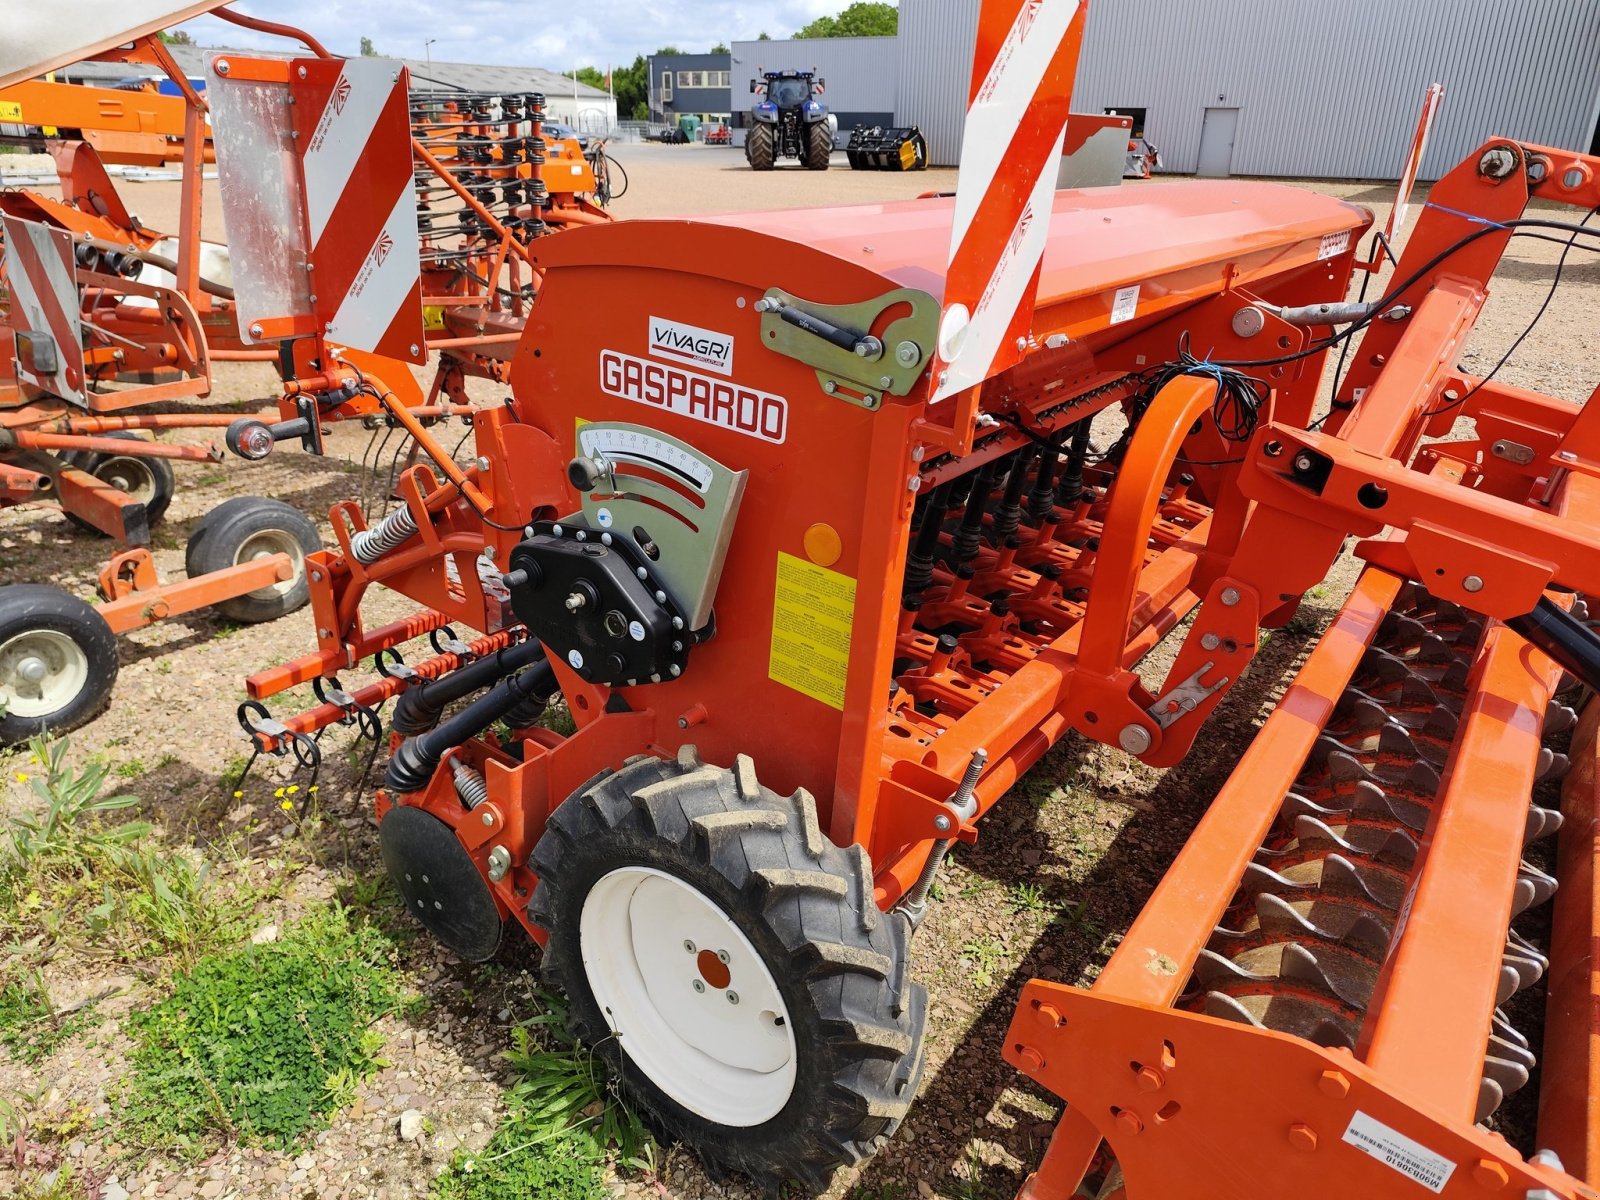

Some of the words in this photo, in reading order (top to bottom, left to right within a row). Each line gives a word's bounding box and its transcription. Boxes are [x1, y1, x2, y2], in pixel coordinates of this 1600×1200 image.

[602, 353, 784, 440] GASPARDO
[605, 431, 612, 439] 10
[618, 432, 625, 440] 15
[642, 437, 649, 445] 25
[654, 441, 662, 449] 30
[667, 446, 674, 455] 35
[679, 453, 687, 461] 40
[692, 460, 699, 469] 45
[704, 468, 711, 477] 50
